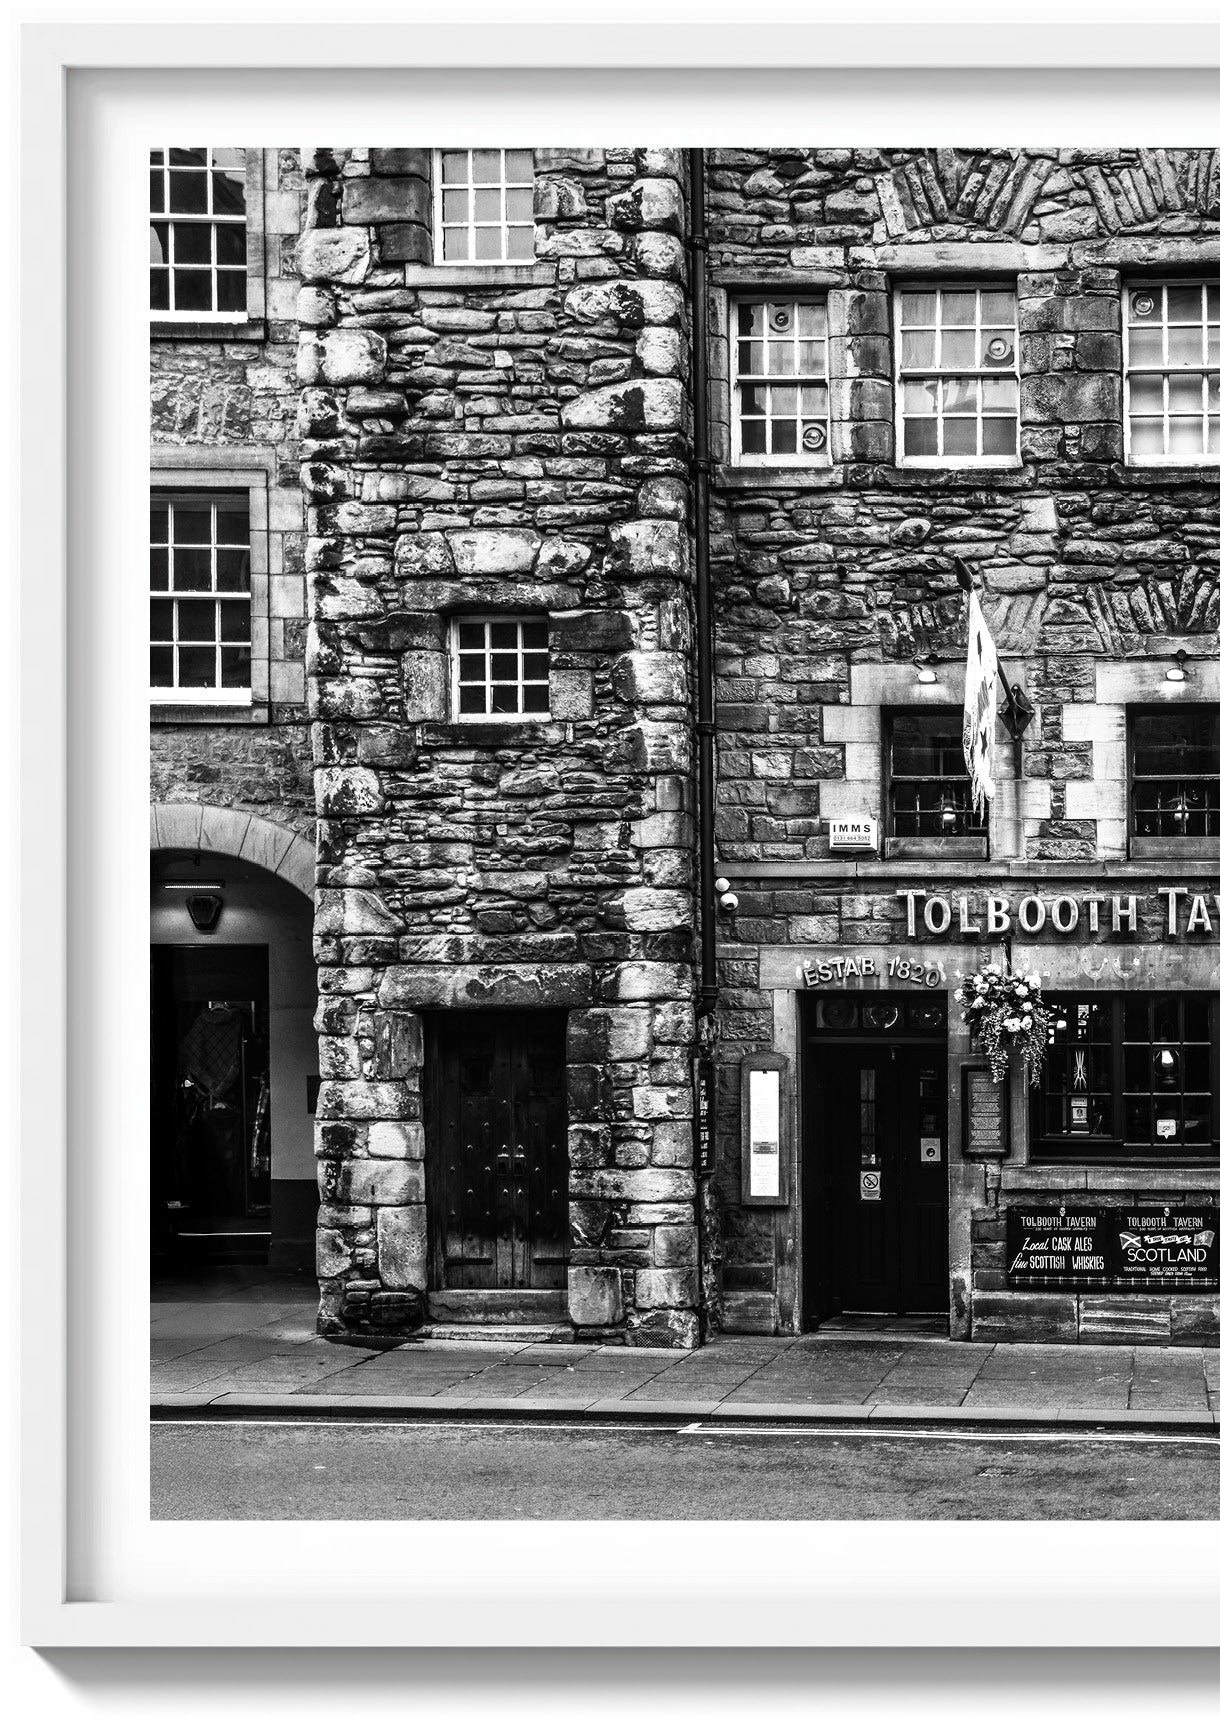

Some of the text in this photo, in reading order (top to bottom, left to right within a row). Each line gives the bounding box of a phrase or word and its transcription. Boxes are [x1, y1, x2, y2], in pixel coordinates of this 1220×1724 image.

[833, 824, 871, 833] IMMS
[896, 889, 1138, 938] TOLBOOTH
[803, 956, 942, 988] ESTAB. 1820
[1020, 1216, 1097, 1227] TOLBOOTH TAVERN
[1127, 1216, 1203, 1227] TOLBOOTH TAVERN
[1022, 1236, 1093, 1252] Local CASK ALES
[1127, 1248, 1207, 1262] SCOTLAND
[1008, 1252, 1105, 1274] fine SCOTTISH WHISKIES
